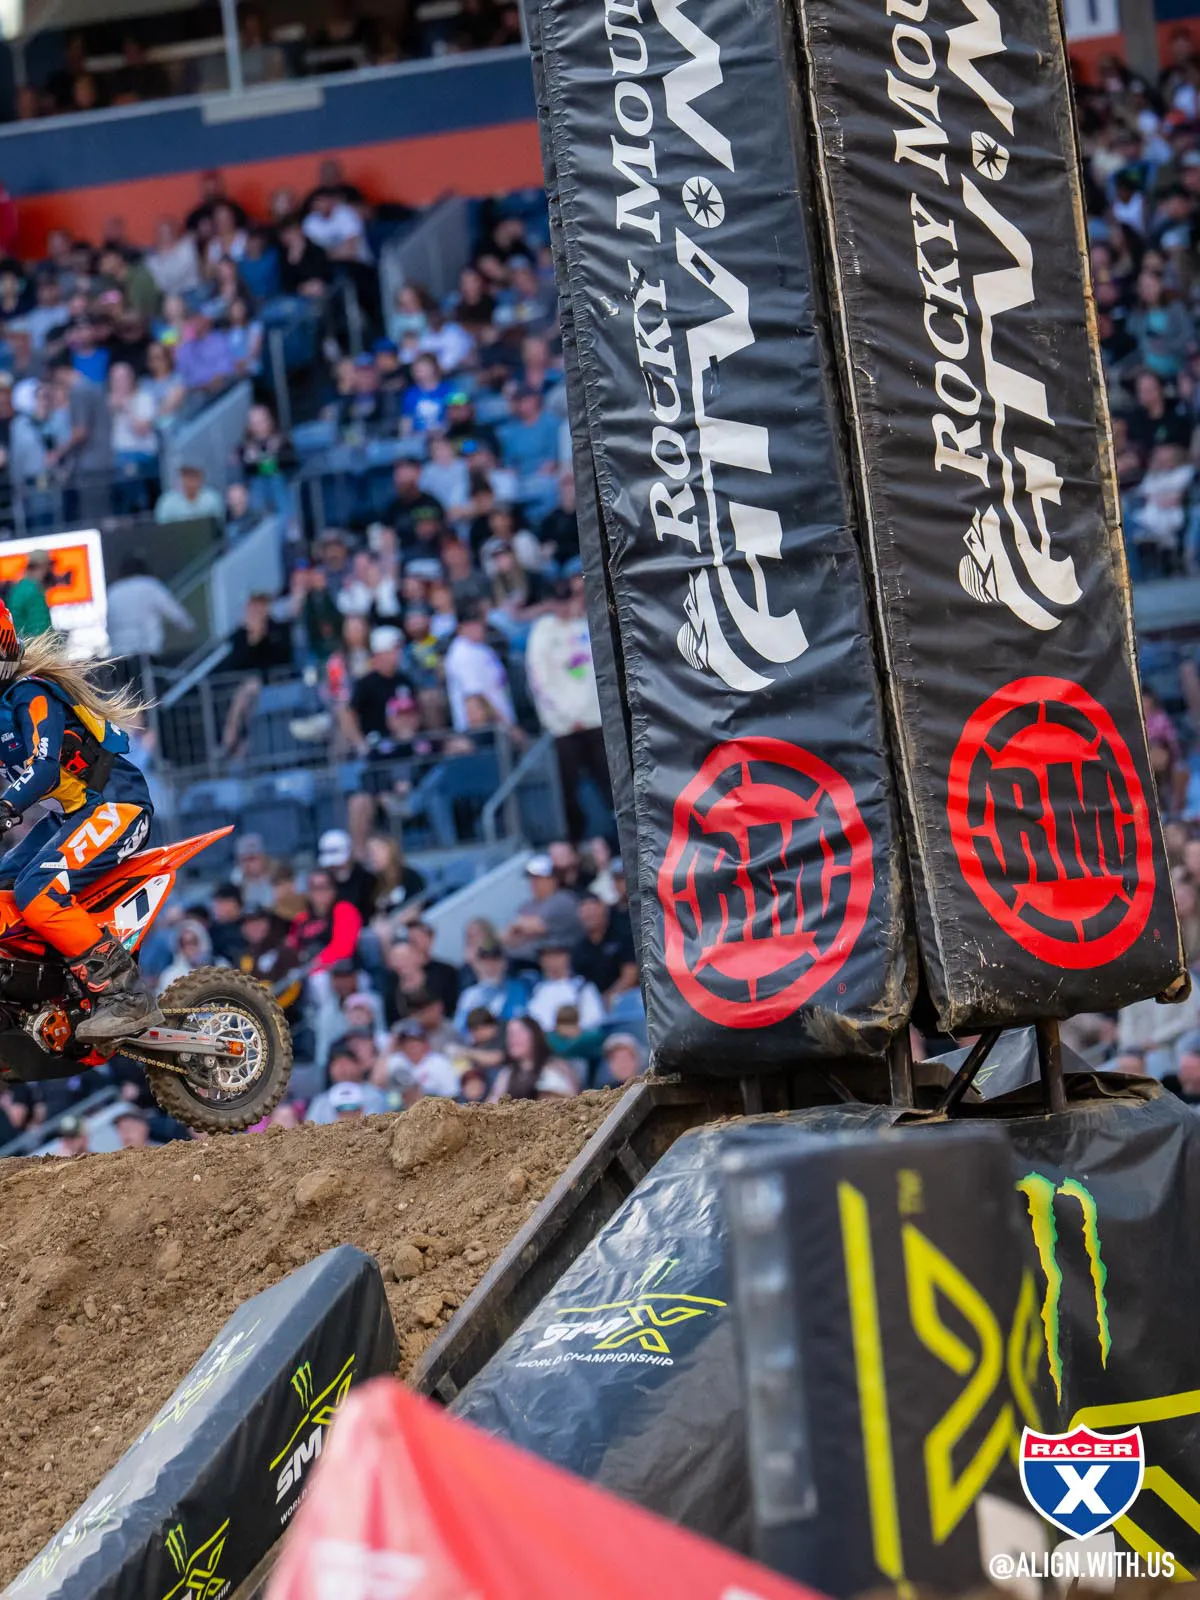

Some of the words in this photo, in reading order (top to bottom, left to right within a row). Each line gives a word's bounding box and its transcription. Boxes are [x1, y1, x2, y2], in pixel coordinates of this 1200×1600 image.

[911, 192, 990, 488] ROCKY
[628, 259, 702, 553] ROCKY
[37, 736, 49, 761] KTM
[14, 765, 35, 792] FLY
[67, 802, 122, 864] FLY
[121, 887, 150, 922] 7
[515, 1355, 561, 1368] WORLD
[565, 1351, 674, 1368] CHAMPIONSHIP
